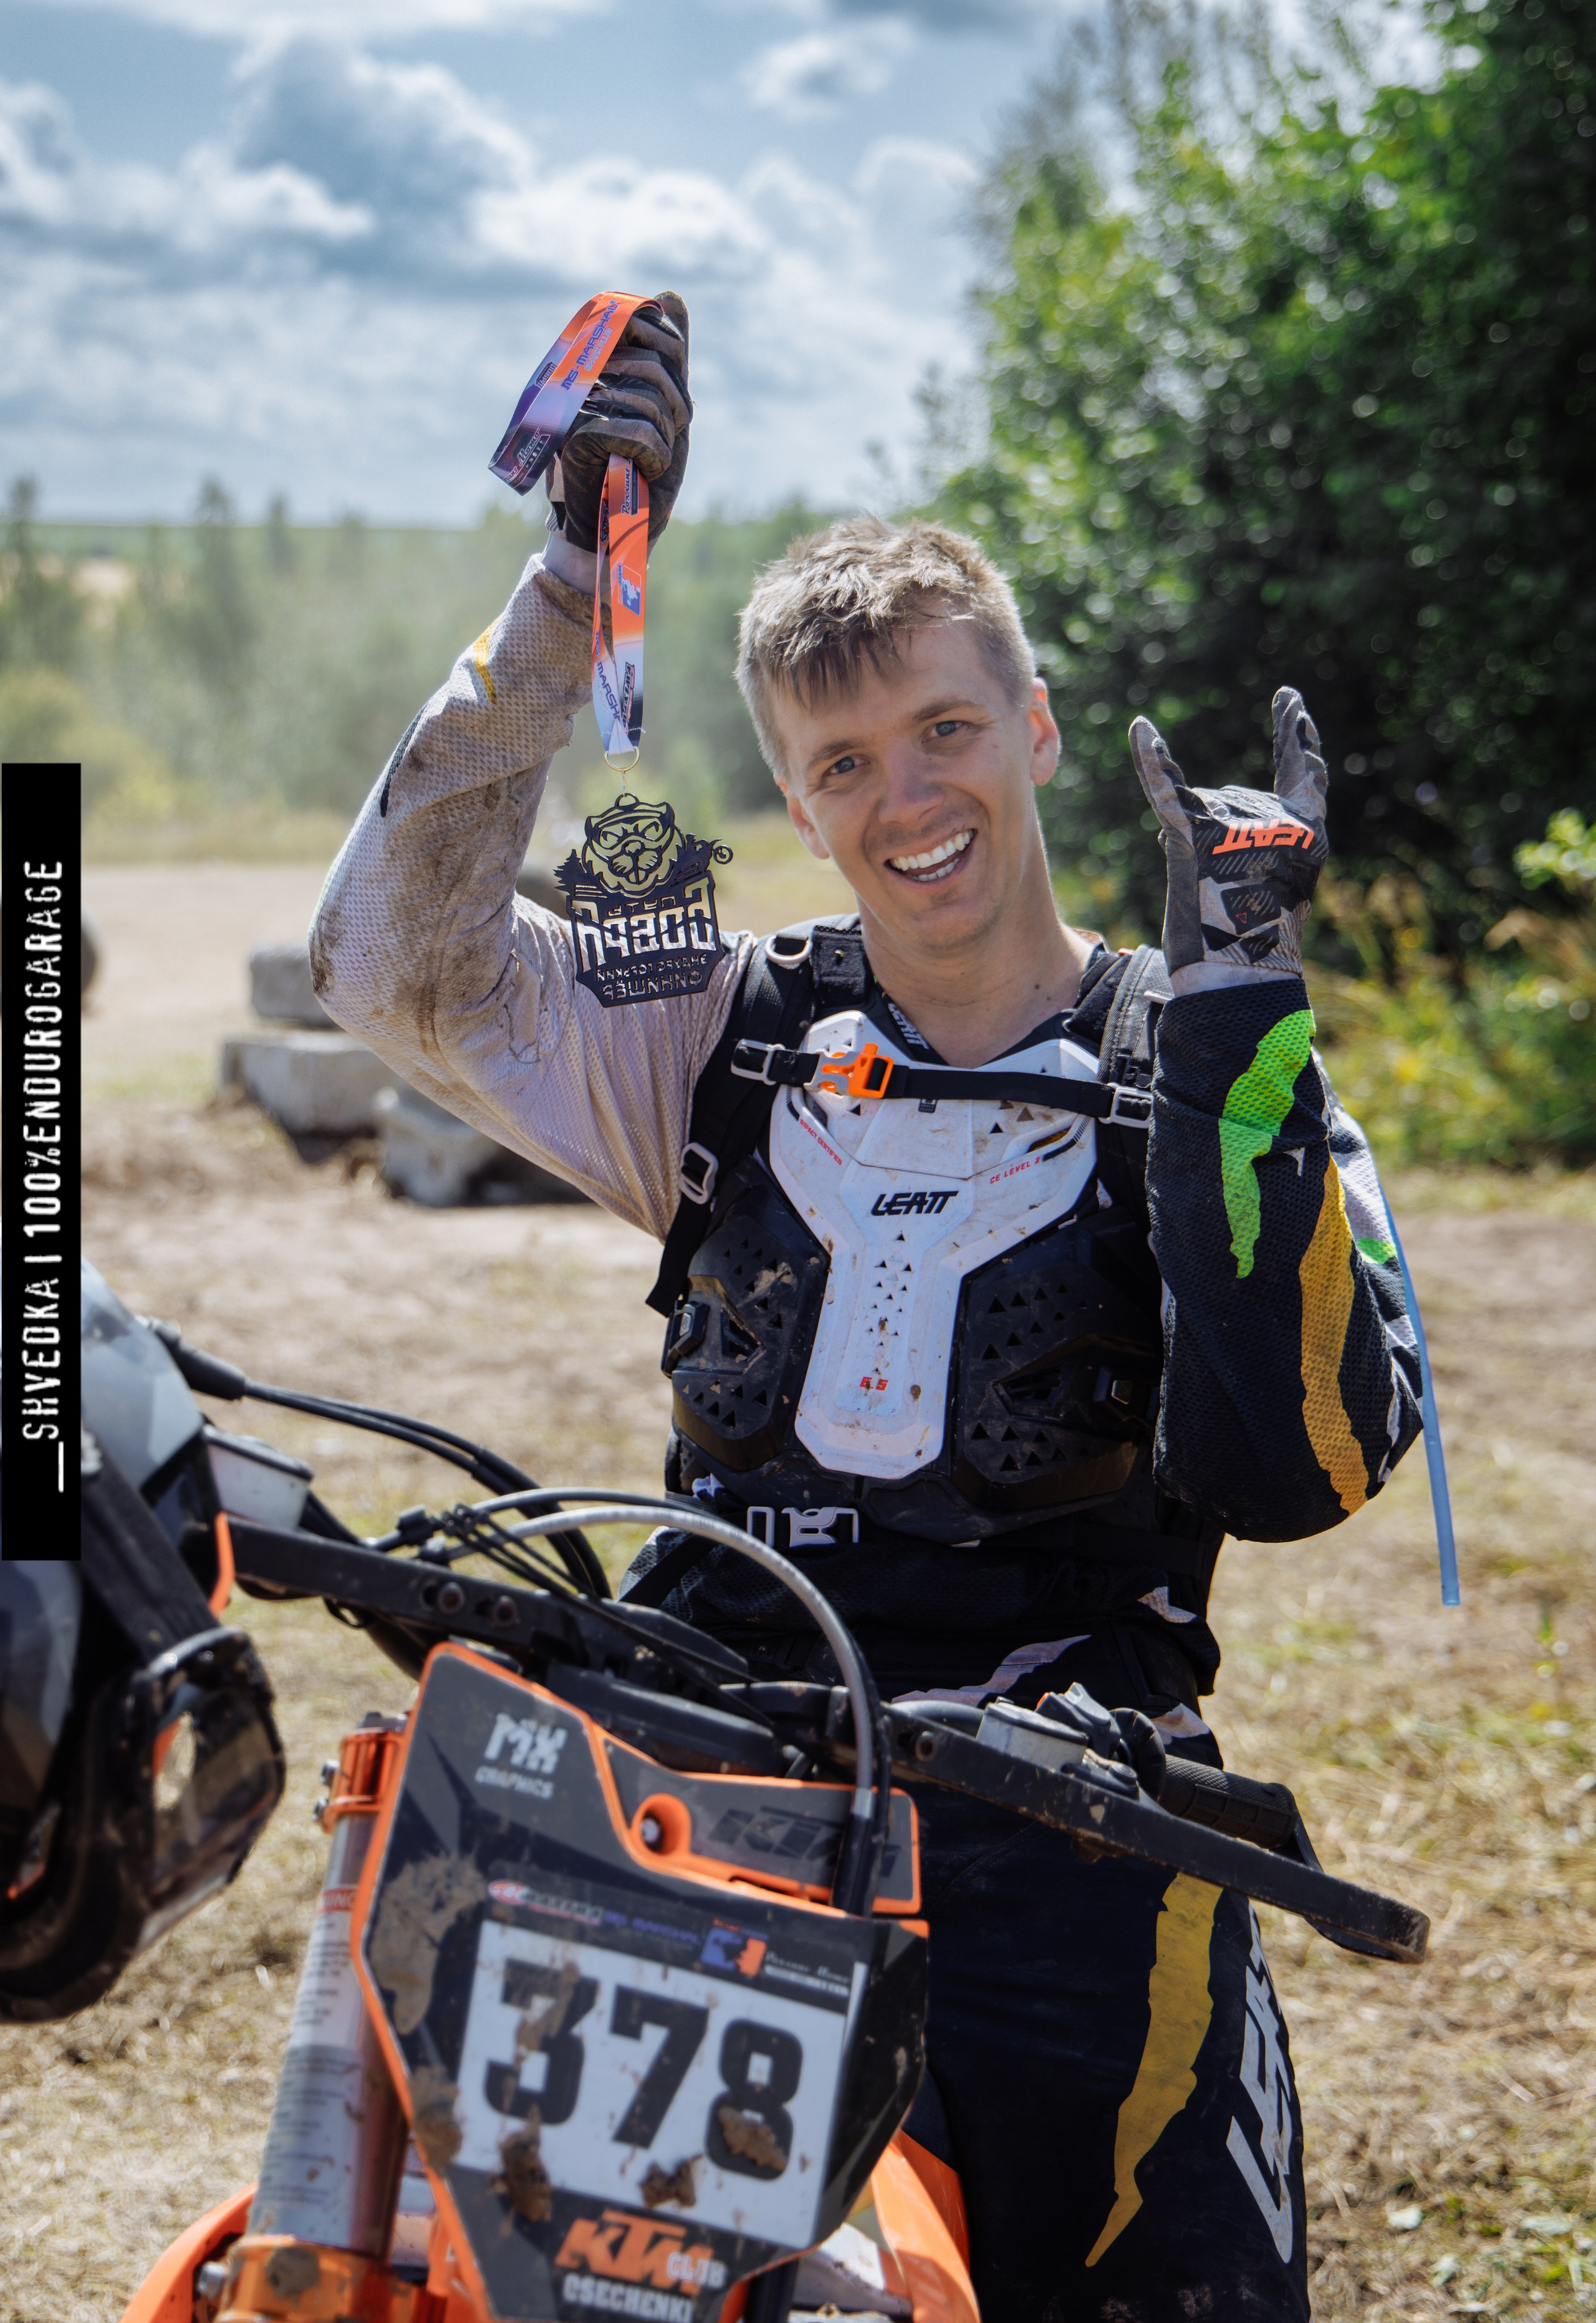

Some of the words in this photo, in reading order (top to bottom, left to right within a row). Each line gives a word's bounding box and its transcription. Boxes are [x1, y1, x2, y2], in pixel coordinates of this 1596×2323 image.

[585, 348, 603, 371] SPARK
[599, 328, 613, 350] PLUG
[1212, 819, 1314, 855] LEATT
[888, 1003, 930, 1051] LEATT
[800, 1118, 817, 1138] IMPACT
[817, 1137, 842, 1166] CERTIFIED
[990, 1173, 1001, 1184] CE
[1004, 1162, 1031, 1178] LEVEL
[870, 1191, 959, 1216] LEATT
[484, 1713, 568, 1774] MX
[484, 1956, 804, 2182] 378
[554, 2208, 714, 2297] KTM
[667, 2251, 728, 2289] CLUB
